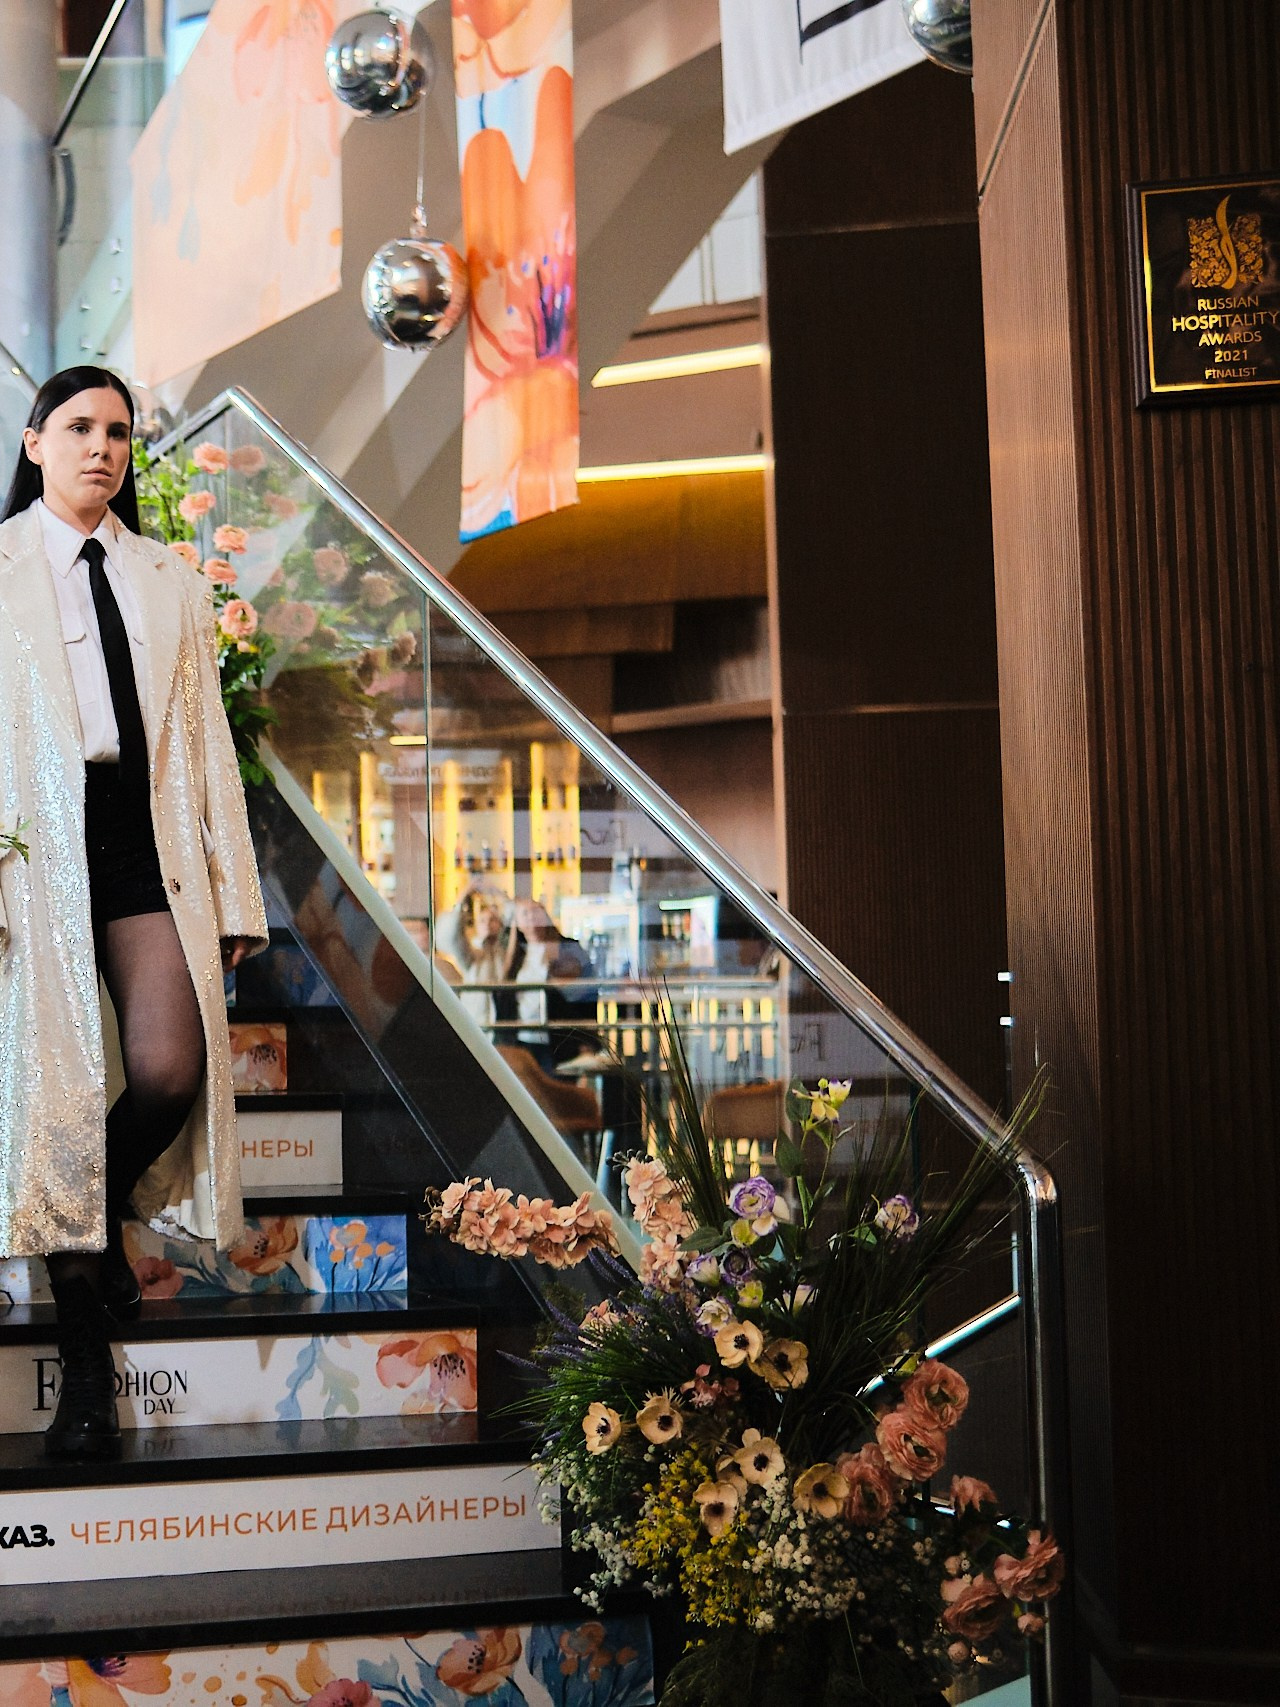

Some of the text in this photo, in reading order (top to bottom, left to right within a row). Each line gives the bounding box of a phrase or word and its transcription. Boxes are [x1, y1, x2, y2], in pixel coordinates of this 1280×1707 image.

[1197, 296, 1259, 311] RUSSIAN
[1172, 311, 1279, 332] HOSPITALITY
[1198, 331, 1263, 347] AWARDS
[1214, 349, 1249, 363] 2021
[1204, 366, 1257, 380] FINALIST
[144, 1398, 178, 1415] DAY
[70, 1508, 318, 1545] ЧЕЛЯБИНСКИЕ
[325, 1494, 527, 1533] ДИЗАЙНЕРЫ
